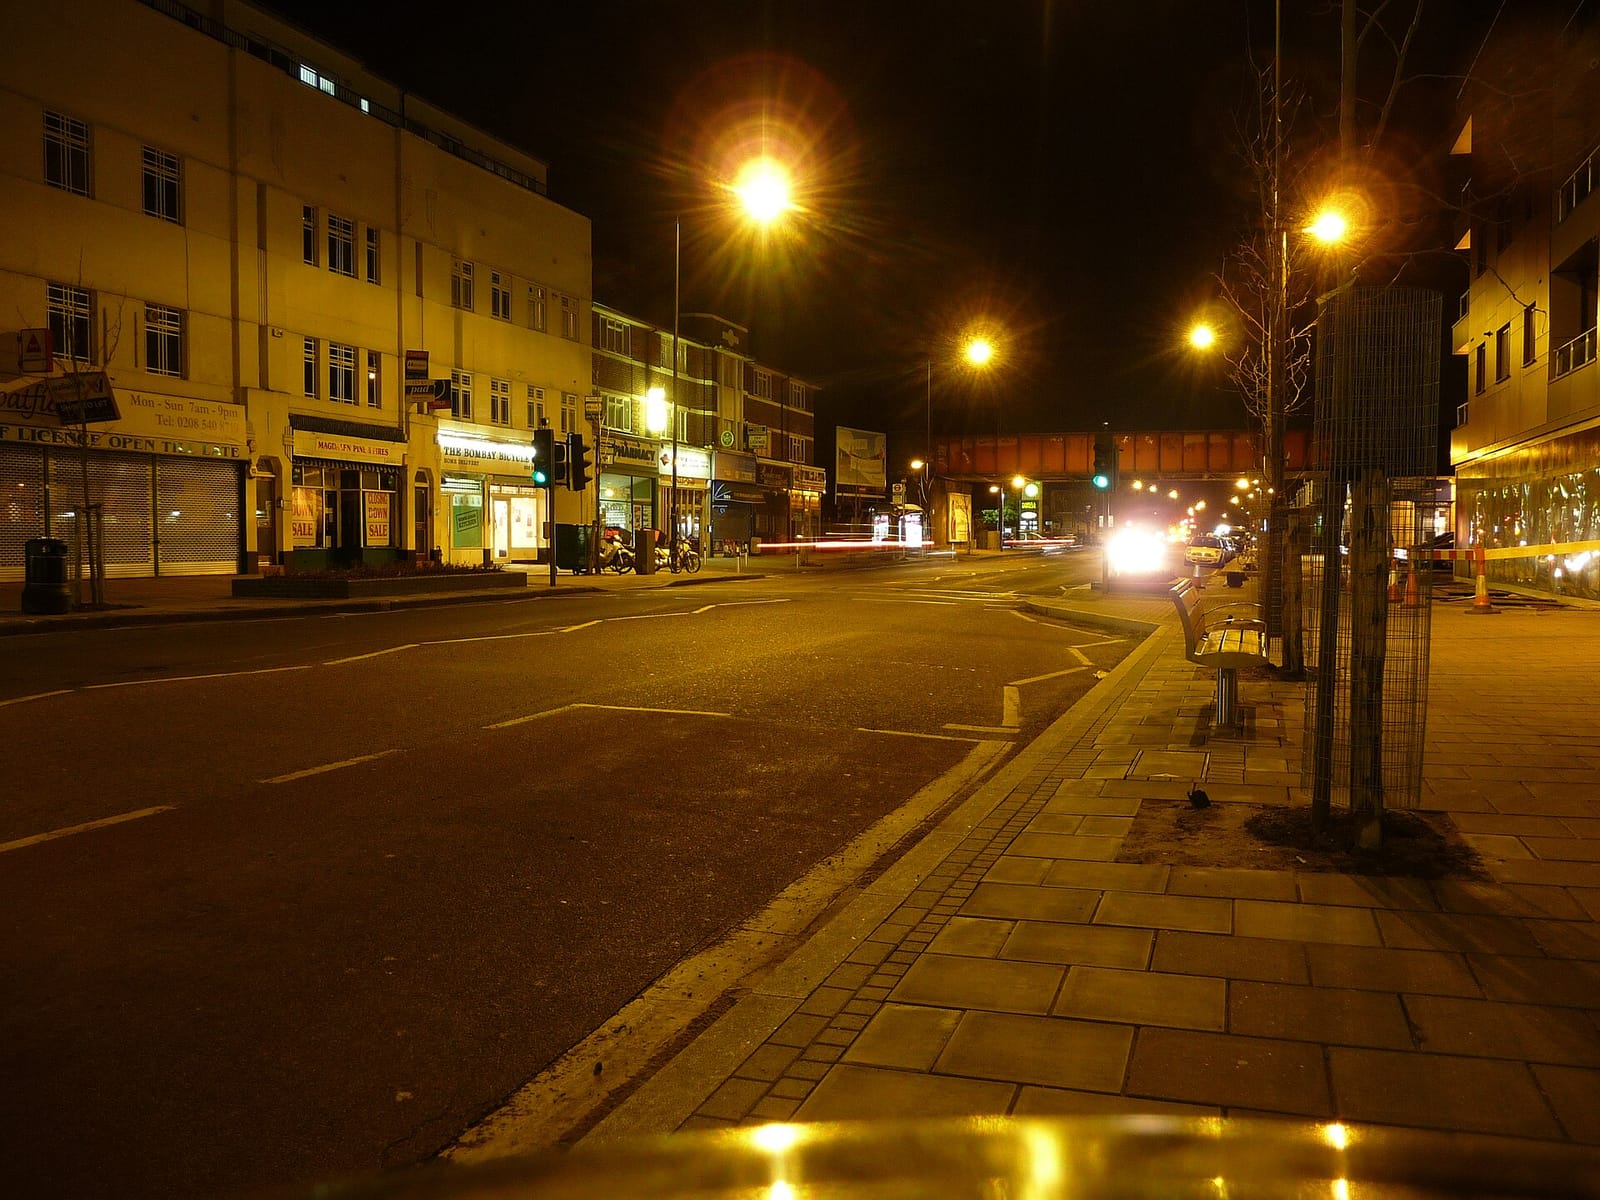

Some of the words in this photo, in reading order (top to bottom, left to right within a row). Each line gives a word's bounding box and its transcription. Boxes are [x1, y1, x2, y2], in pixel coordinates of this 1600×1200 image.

[130, 394, 155, 408] Mon
[164, 399, 184, 411] Sun
[189, 402, 209, 415] 7am
[217, 404, 238, 420] 9pm
[155, 413, 174, 426] Tel:
[177, 416, 199, 429] 0208
[109, 436, 155, 452] OPEN
[202, 445, 240, 458] LATE
[444, 446, 461, 457] THE
[464, 448, 496, 460] BOMBAY
[499, 451, 530, 463] BICYCLE
[614, 443, 656, 462] PHARMACY
[368, 493, 388, 504] CLOSING
[368, 507, 388, 519] DOWN
[292, 522, 313, 536] SALE
[368, 524, 388, 537] SALE
